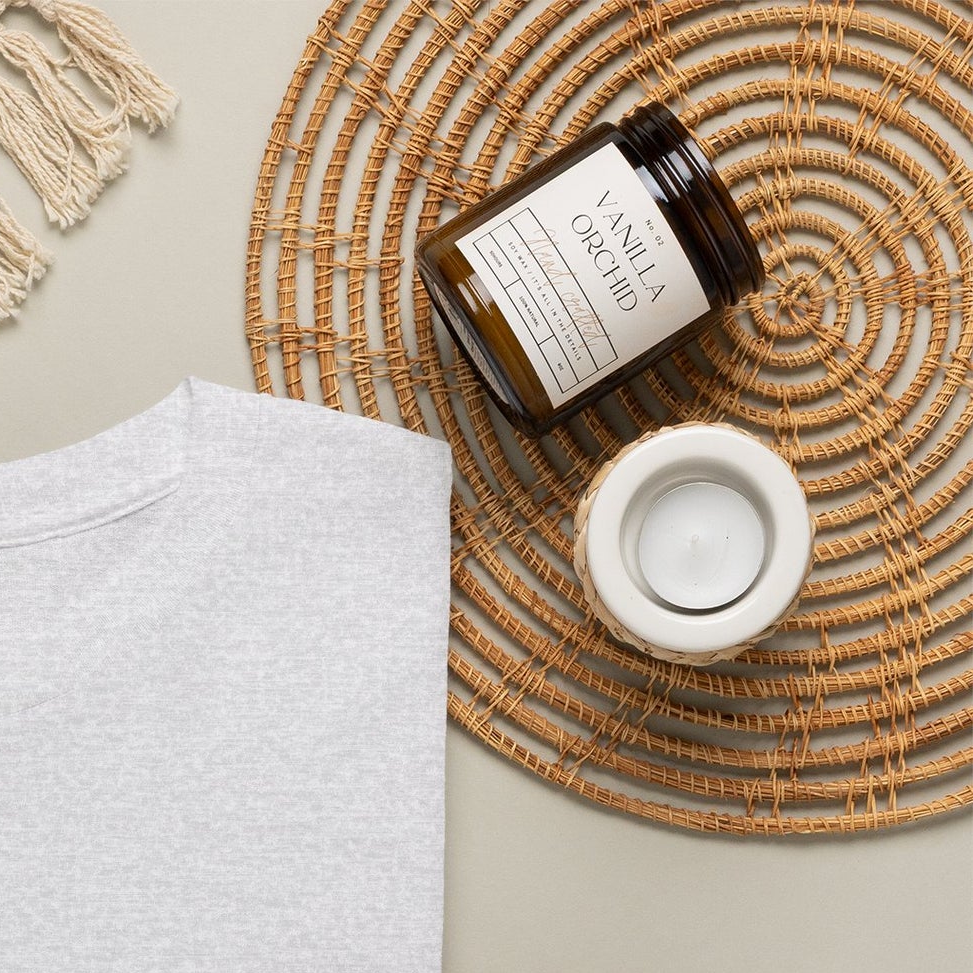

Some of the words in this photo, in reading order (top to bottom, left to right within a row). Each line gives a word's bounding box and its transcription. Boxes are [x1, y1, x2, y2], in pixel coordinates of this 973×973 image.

[571, 214, 638, 312] ORCHID
[596, 190, 666, 302] VANILLA
[654, 235, 664, 246] 02
[508, 241, 519, 253] SOY
[518, 255, 528, 269] WAX
[531, 276, 542, 291] IT'S
[541, 293, 551, 306] ALL
[556, 318, 567, 332] THE
[564, 333, 582, 361] DETAILS
[526, 307, 540, 328] NATURAL
